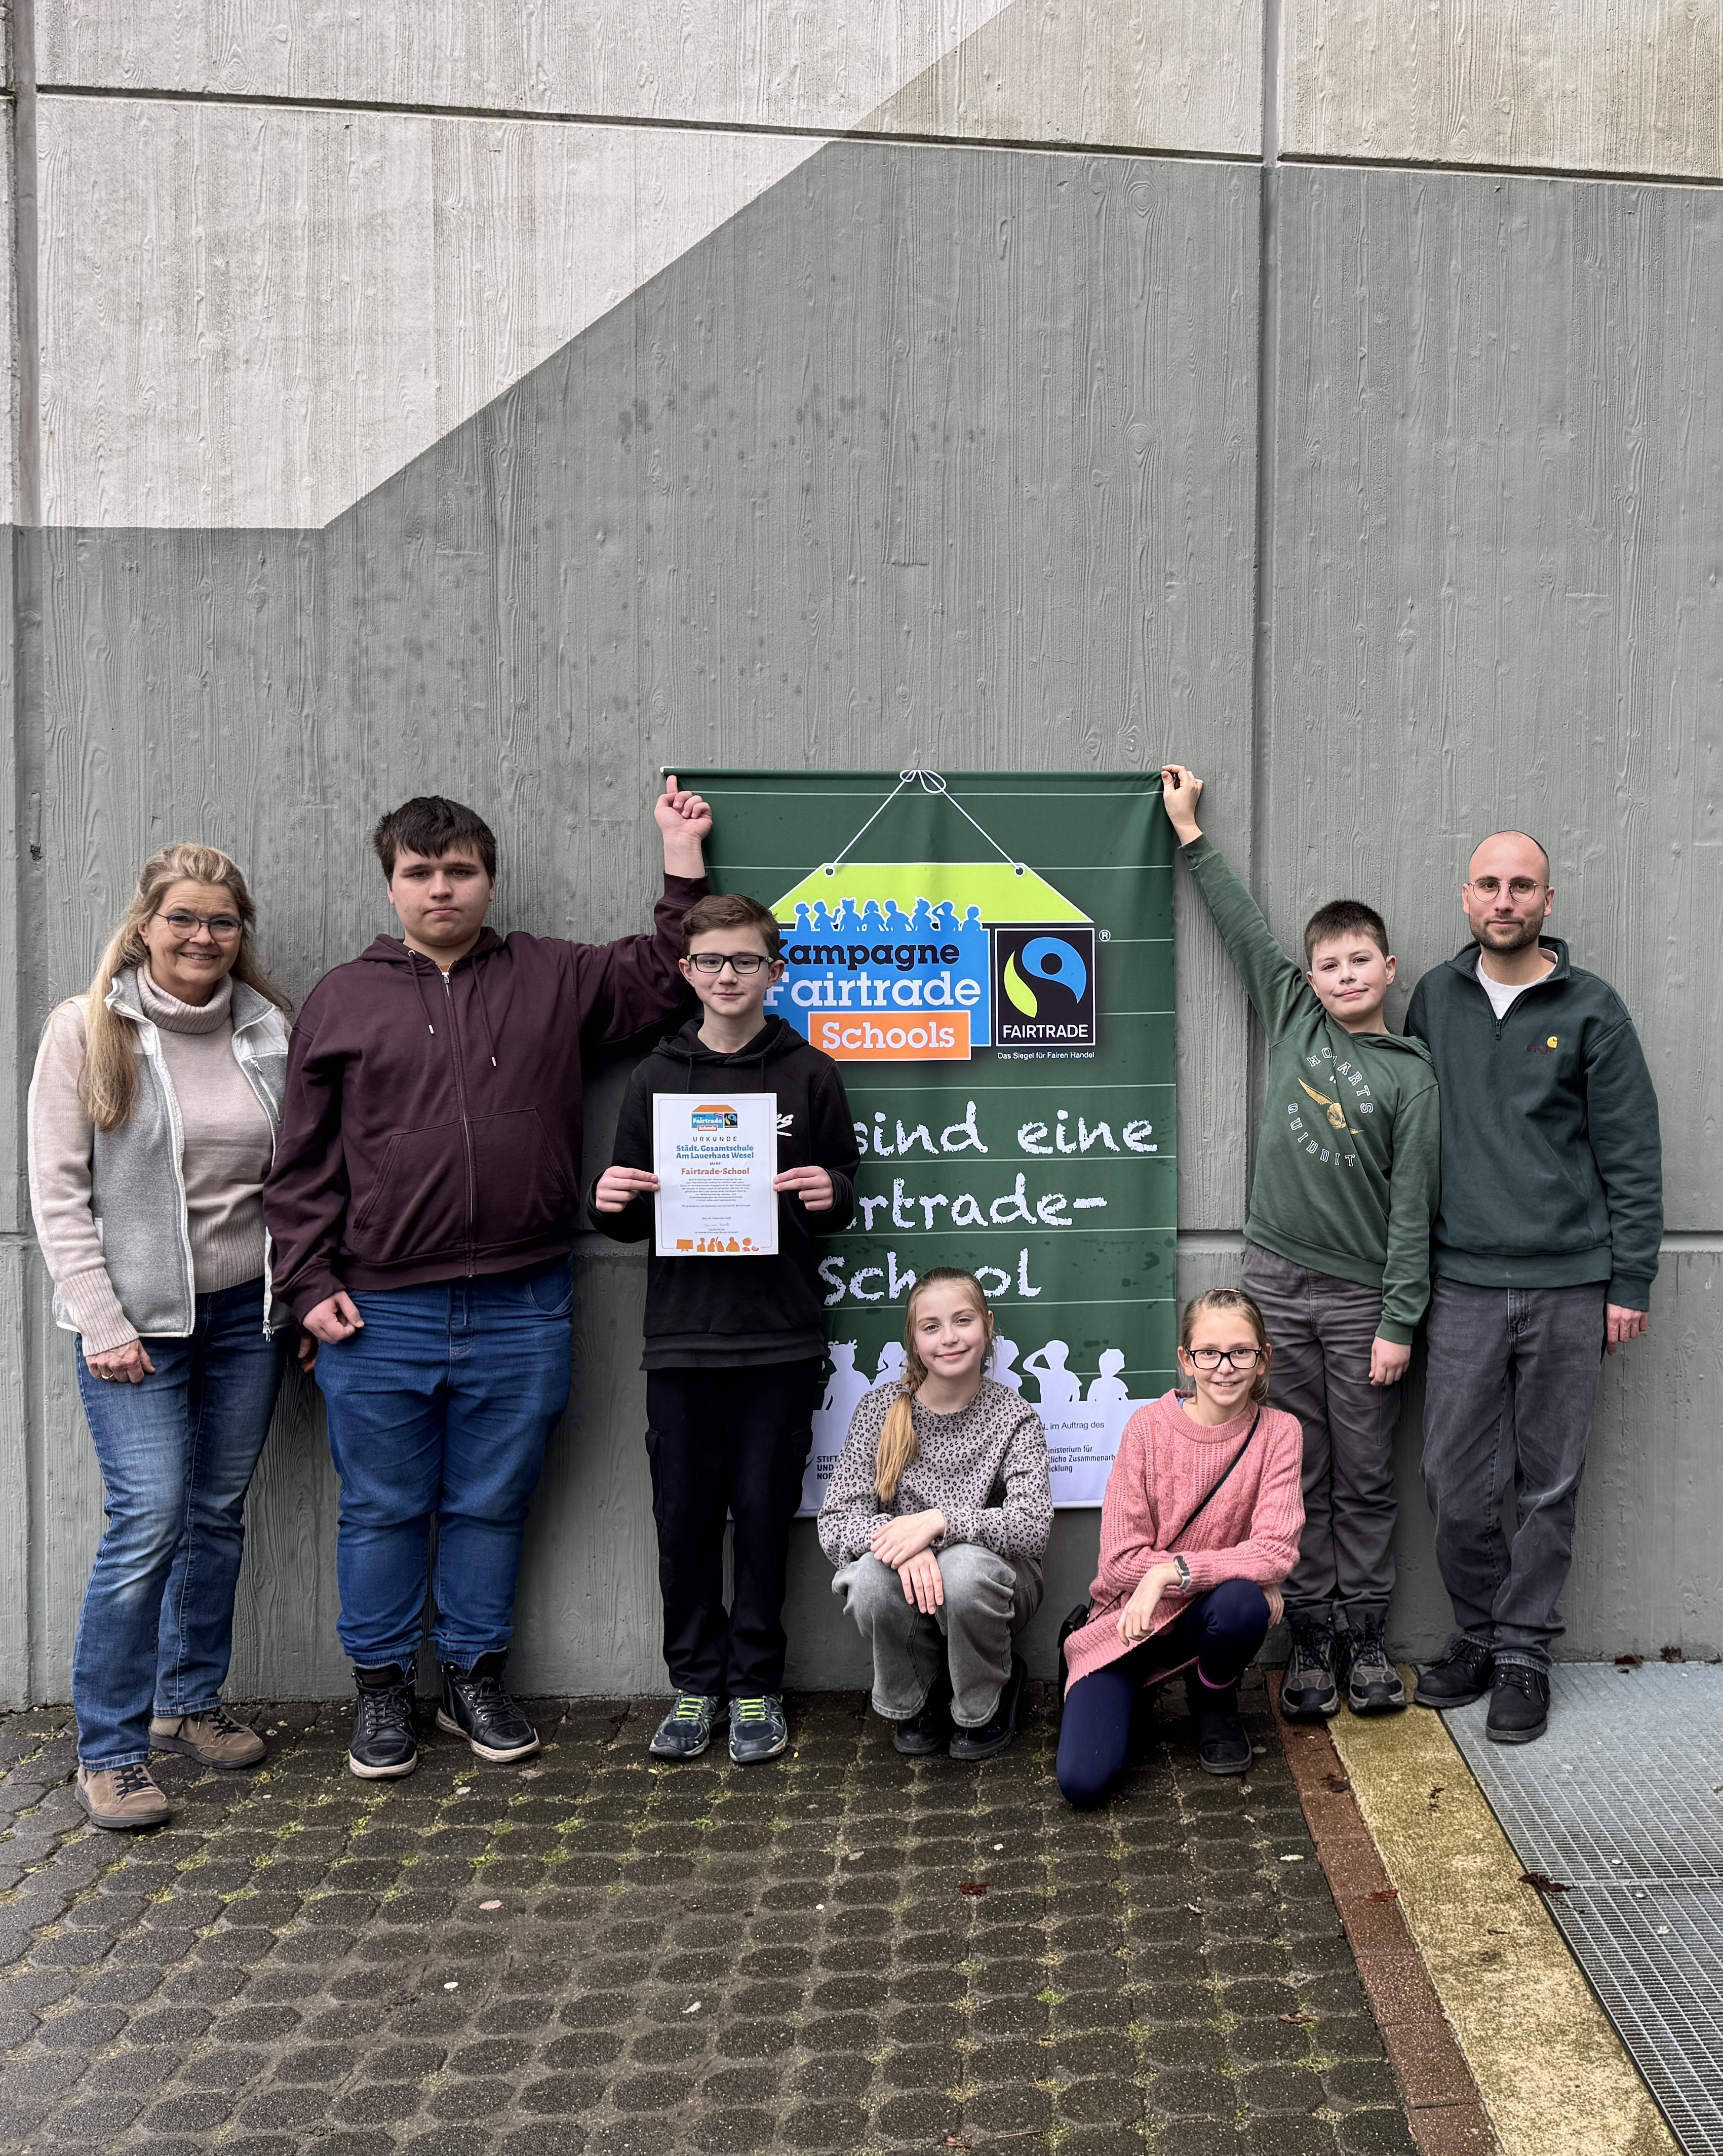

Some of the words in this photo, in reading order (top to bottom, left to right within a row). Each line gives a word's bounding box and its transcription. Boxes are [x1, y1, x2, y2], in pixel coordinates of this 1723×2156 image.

[822, 1021, 955, 1049] Schools
[1002, 1024, 1088, 1038] FAIRTRADE
[1013, 1052, 1034, 1060] Siegel
[853, 1100, 988, 1157] sind
[1017, 1109, 1158, 1155] eine
[846, 1172, 1108, 1231] rtrade-
[818, 1247, 1042, 1306] Schol
[1061, 1422, 1088, 1430] Auftrag
[1048, 1446, 1081, 1454] inisterium
[1083, 1445, 1092, 1453] für
[1049, 1464, 1073, 1473] icklung
